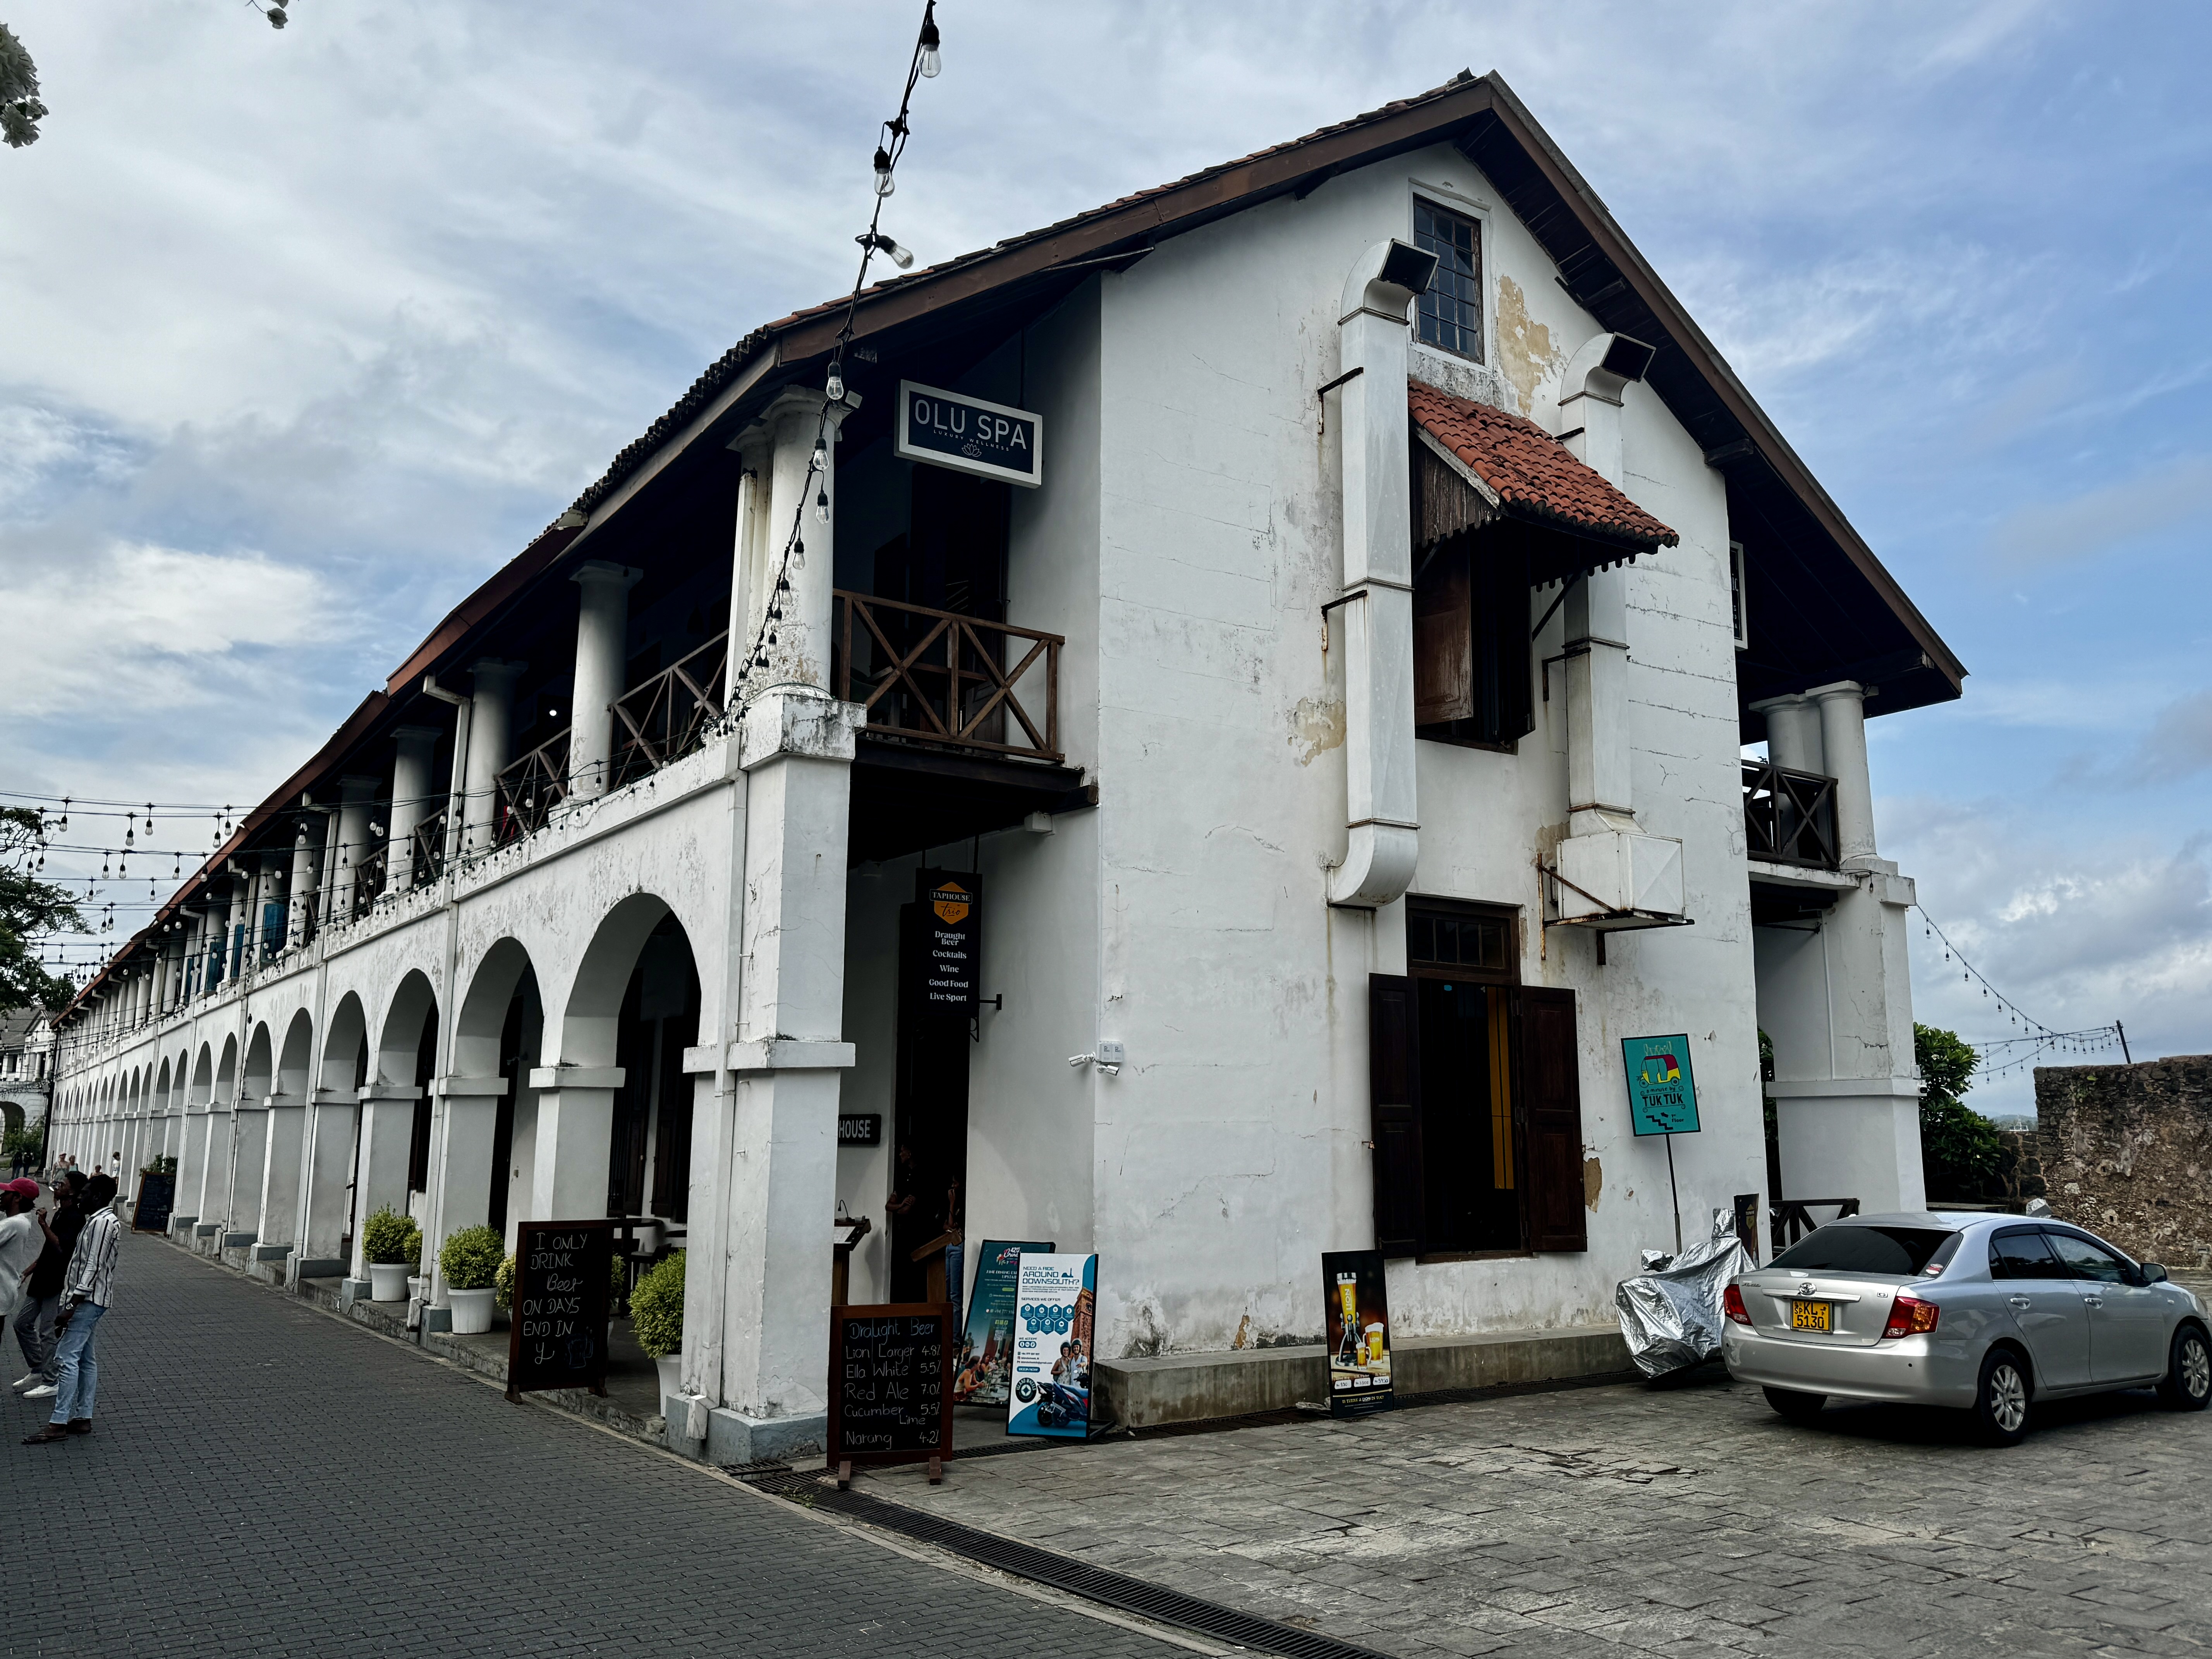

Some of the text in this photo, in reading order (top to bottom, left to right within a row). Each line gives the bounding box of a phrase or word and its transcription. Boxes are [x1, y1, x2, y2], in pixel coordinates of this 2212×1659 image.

[915, 399, 1027, 450] OLU SPA
[934, 429, 1009, 451] LUXURY WELLNESS
[932, 891, 970, 901] TAPHOUSE
[940, 903, 961, 917] trio
[935, 931, 965, 940] Draught
[933, 950, 967, 959] Cocktails
[939, 964, 959, 973] Wine
[929, 979, 949, 987] Good
[930, 992, 967, 1002] Live Sport
[1642, 1093, 1684, 1107] TUK TUK
[839, 1120, 871, 1138] HOUSE
[535, 1232, 587, 1250] I ONLY
[530, 1252, 574, 1270] DRINK
[546, 1273, 583, 1292] Beer
[523, 1297, 581, 1316] ON DAYS
[1345, 1288, 1353, 1310] LION
[1803, 1302, 1818, 1315] KL
[523, 1320, 574, 1337] END IN
[1797, 1314, 1824, 1329] 5130
[849, 1317, 934, 1345] Draught Beer
[846, 1343, 941, 1364] Lion Larger 4.8%
[847, 1360, 941, 1378] Ella White 5.5%
[844, 1381, 940, 1400] Red Ale 7.0%
[845, 1402, 940, 1417] Cucumber 5.5%
[899, 1414, 926, 1425] Lime
[846, 1429, 939, 1450] Narang 4.2%
